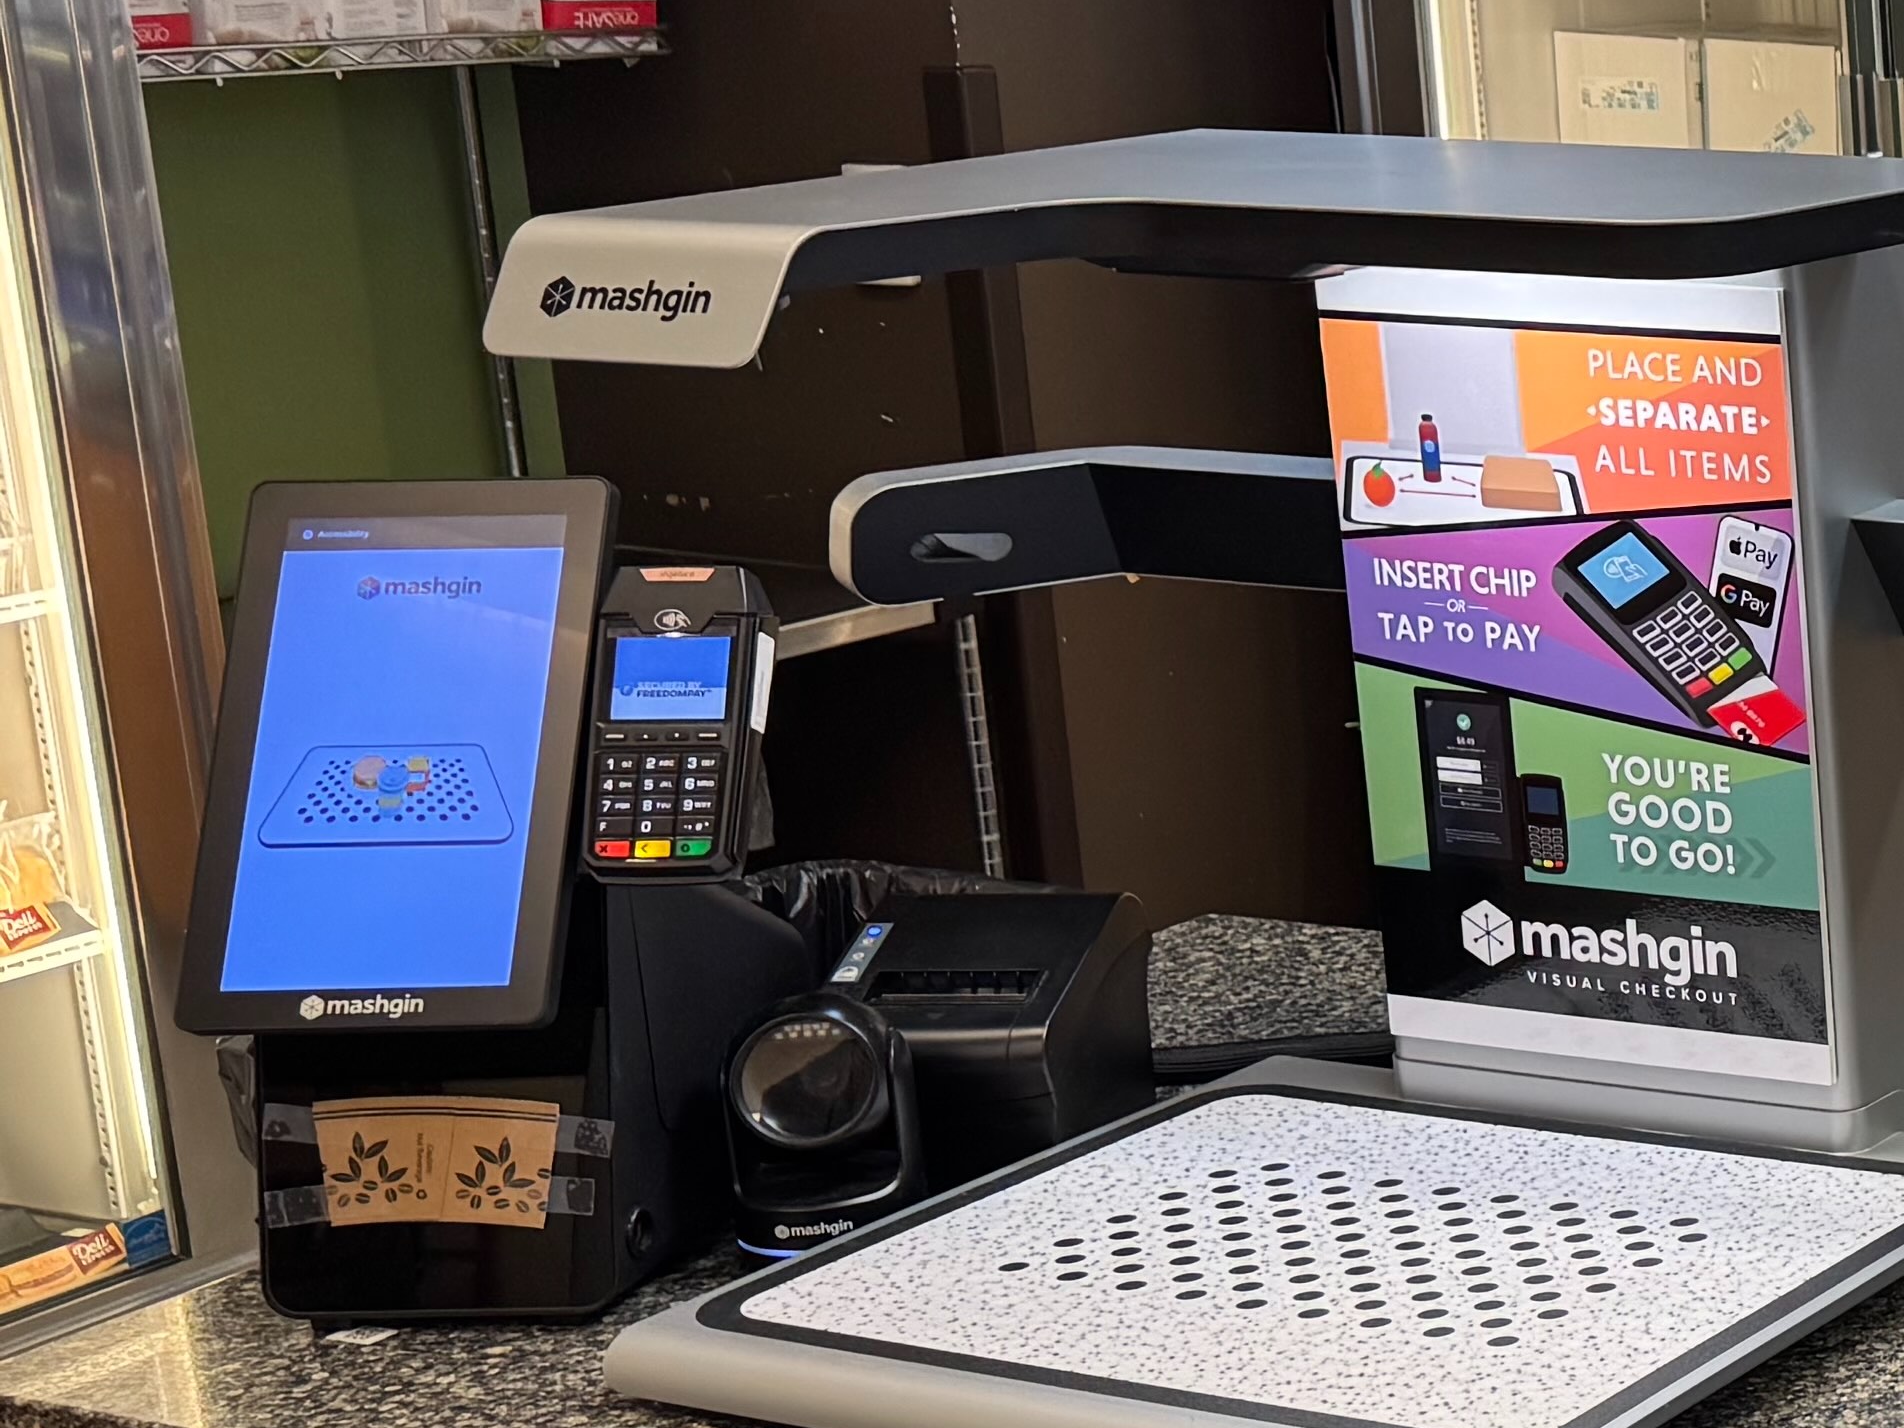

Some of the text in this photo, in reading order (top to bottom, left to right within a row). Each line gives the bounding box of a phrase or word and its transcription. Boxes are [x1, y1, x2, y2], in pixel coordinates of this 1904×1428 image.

[576, 279, 711, 322] mashgin
[1588, 349, 1763, 387] PLACE AND
[1598, 397, 1760, 435] SEPARATE
[1593, 445, 1772, 485] ALL ITEMS
[1745, 543, 1779, 571] Pay
[384, 576, 482, 599] mashgin
[1372, 558, 1537, 598] INSERT CHIP
[1446, 598, 1468, 615] OR
[1741, 591, 1772, 619] Pay
[1377, 612, 1432, 645] TAP
[1484, 621, 1542, 654] PAY
[1601, 752, 1731, 794] YOU'RE
[1607, 791, 1733, 836] GOOD
[1609, 832, 1738, 875] TO GO!
[1519, 916, 1738, 986] mashgin
[326, 992, 425, 1019] mashgin
[1526, 970, 1739, 1006] VISUAL CHECKOUT
[790, 1218, 853, 1239] mashgin
